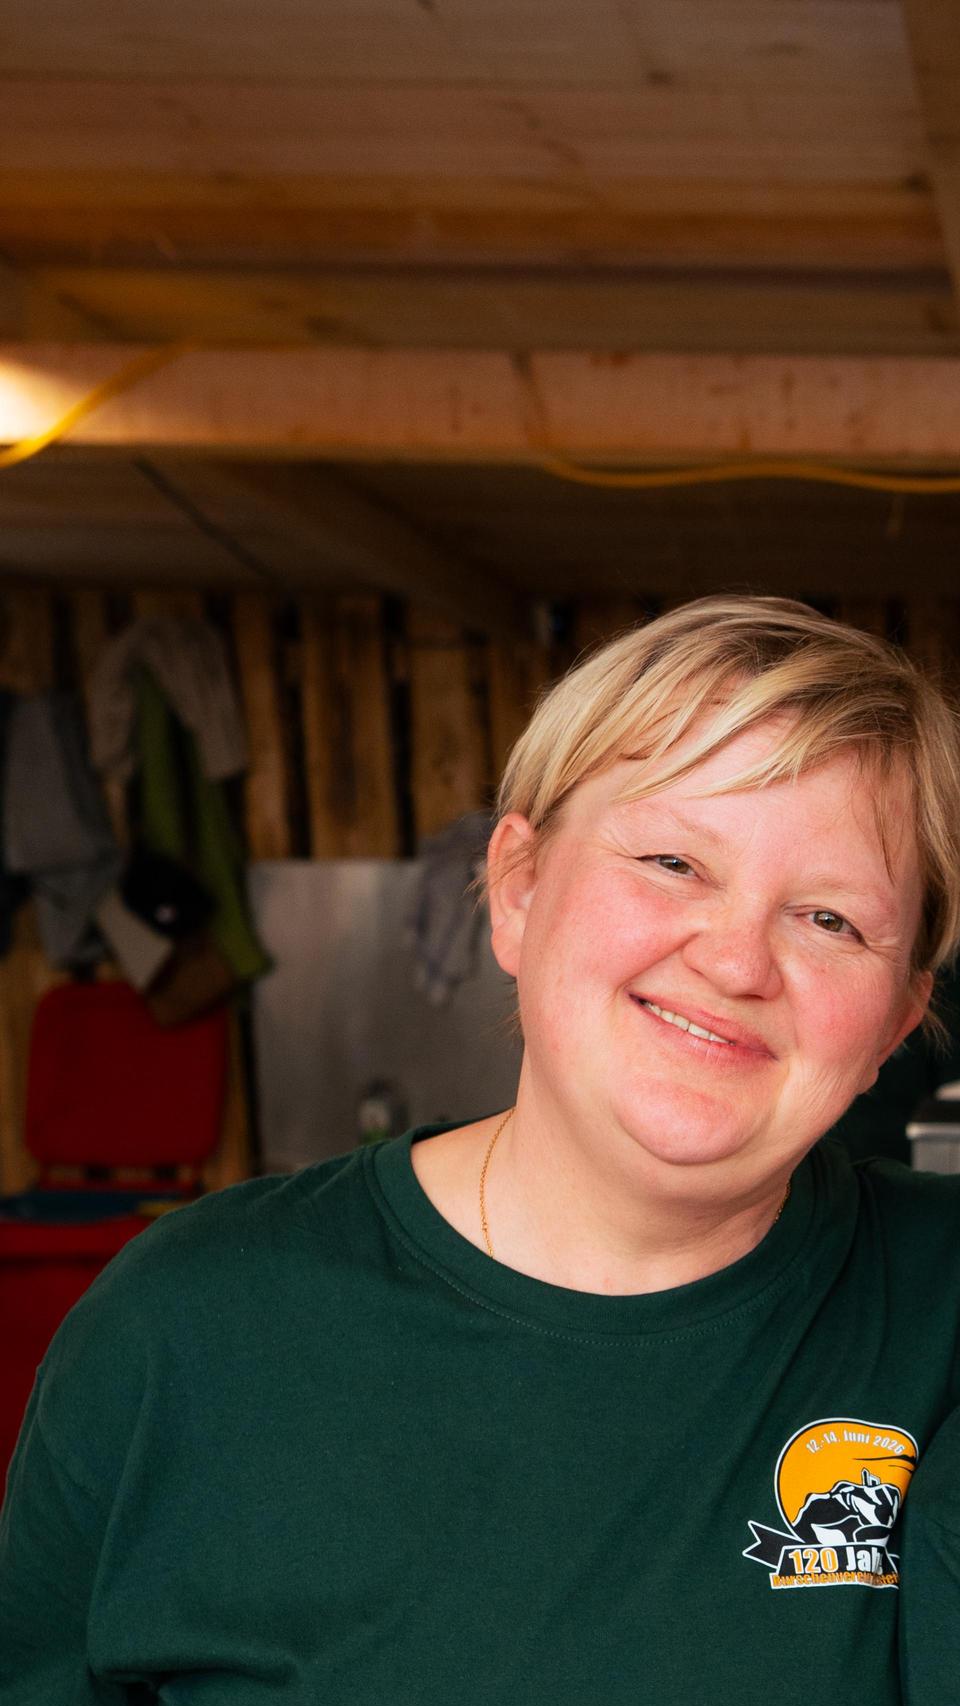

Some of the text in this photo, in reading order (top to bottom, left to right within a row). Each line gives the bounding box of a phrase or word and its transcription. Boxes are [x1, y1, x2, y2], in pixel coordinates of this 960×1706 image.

[843, 1429, 870, 1444] Juni
[873, 1435, 906, 1455] 2026
[788, 1547, 839, 1575] 120
